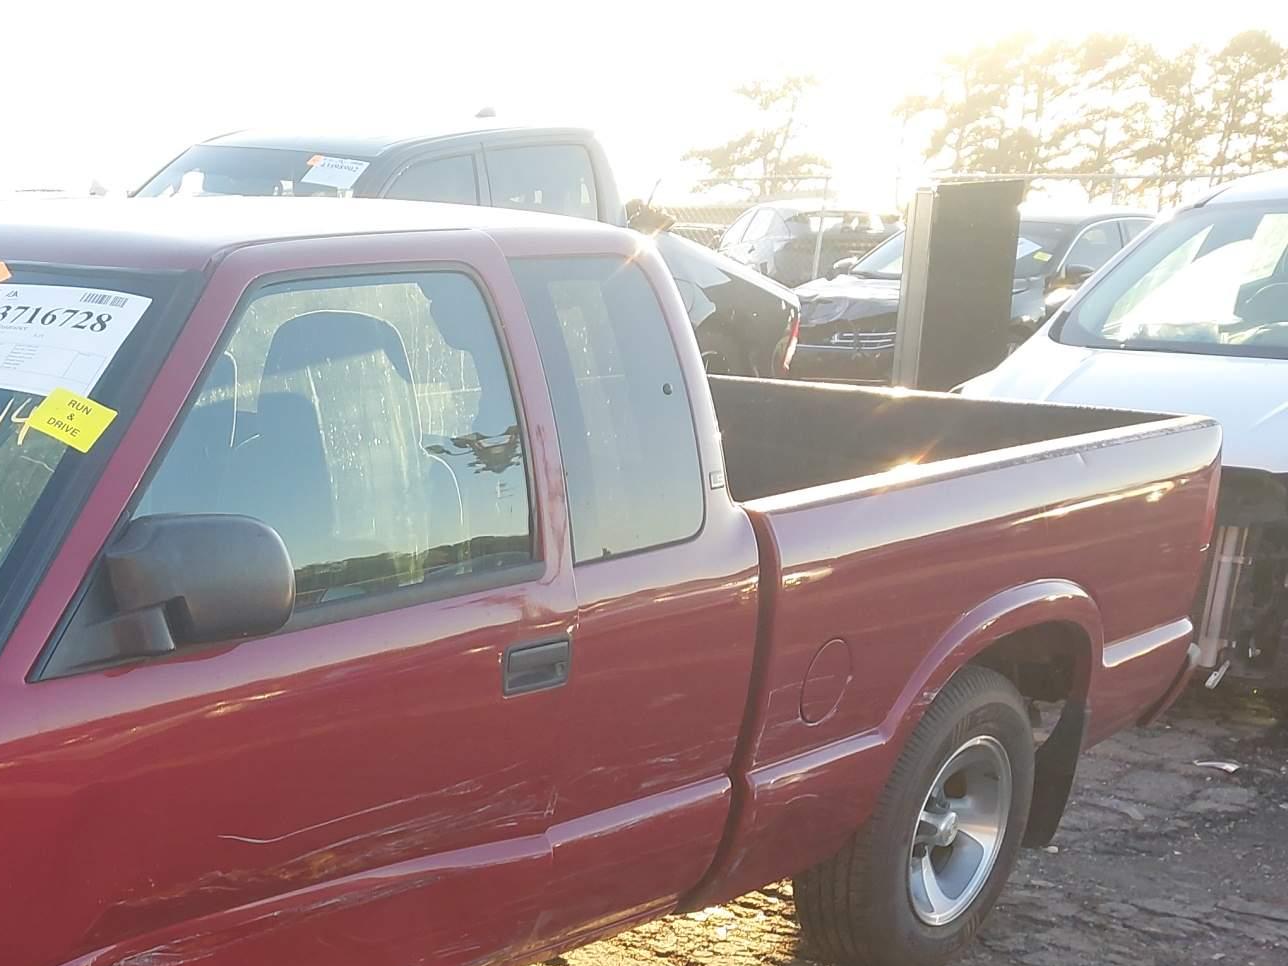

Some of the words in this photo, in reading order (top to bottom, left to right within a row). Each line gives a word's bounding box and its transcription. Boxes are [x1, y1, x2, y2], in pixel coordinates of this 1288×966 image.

[67, 399, 92, 416] RUN
[67, 412, 75, 421] &
[47, 416, 81, 438] DRIVE
